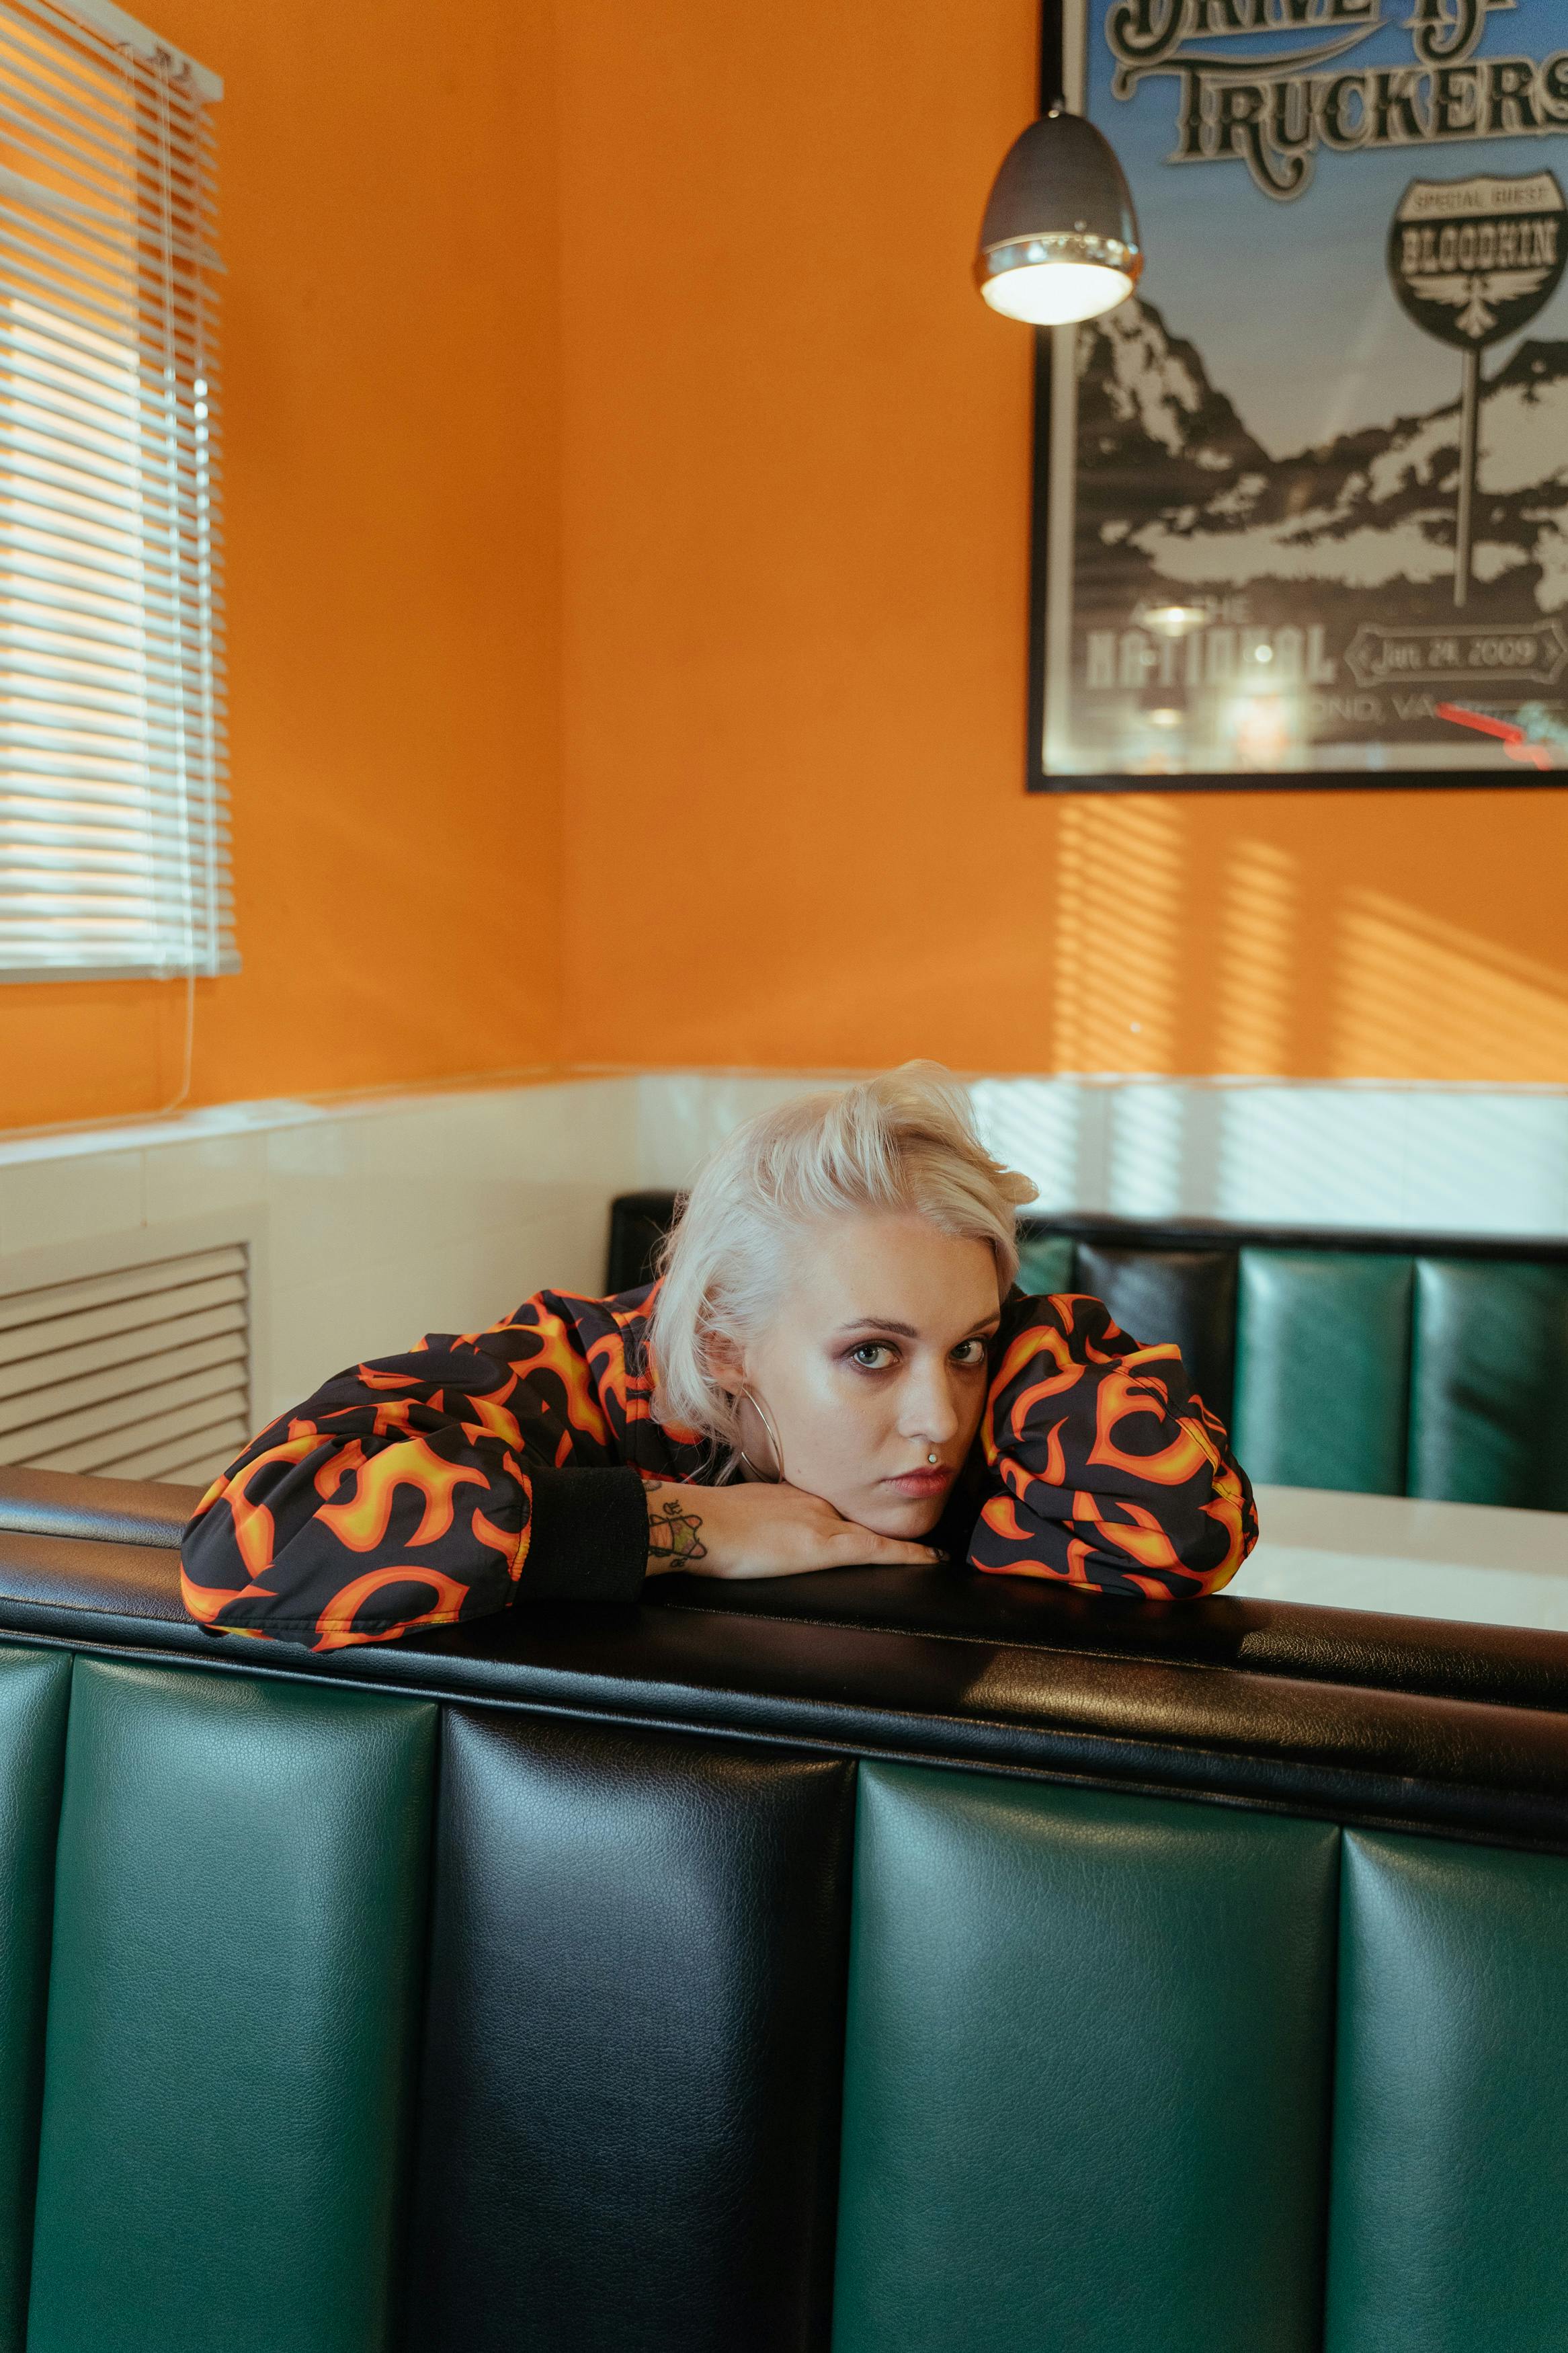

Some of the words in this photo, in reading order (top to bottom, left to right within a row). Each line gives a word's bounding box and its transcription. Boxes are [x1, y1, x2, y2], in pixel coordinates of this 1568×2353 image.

[1112, 51, 1568, 200] TRUCKERS
[1414, 189, 1484, 210] SPECIAL
[1491, 186, 1549, 206] GUEST
[1085, 623, 1336, 689] NATIONAL
